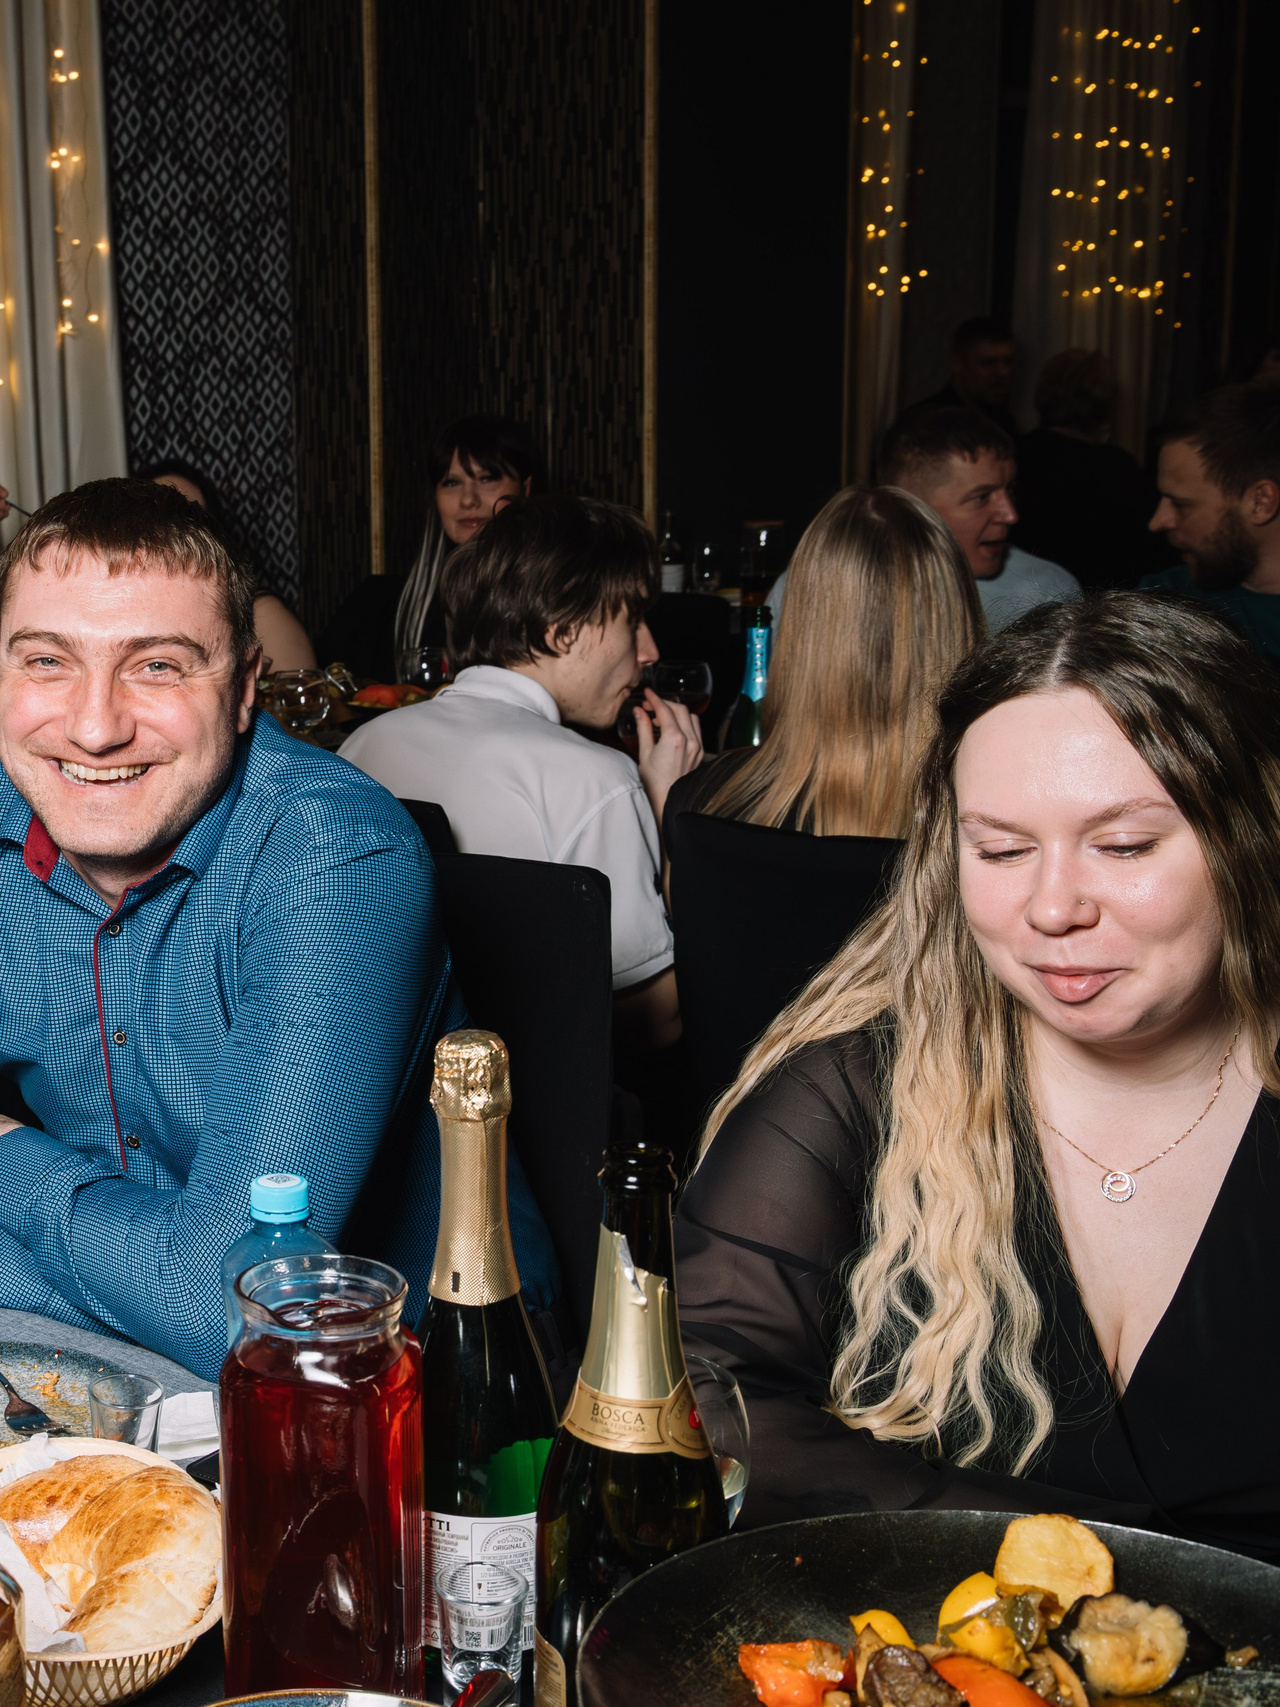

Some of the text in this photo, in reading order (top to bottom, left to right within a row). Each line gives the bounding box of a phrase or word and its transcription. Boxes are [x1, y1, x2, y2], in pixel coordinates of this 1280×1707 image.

[591, 1402, 645, 1425] BOSCA
[425, 1517, 451, 1532] TTI
[492, 1541, 527, 1551] ORIGINALE
